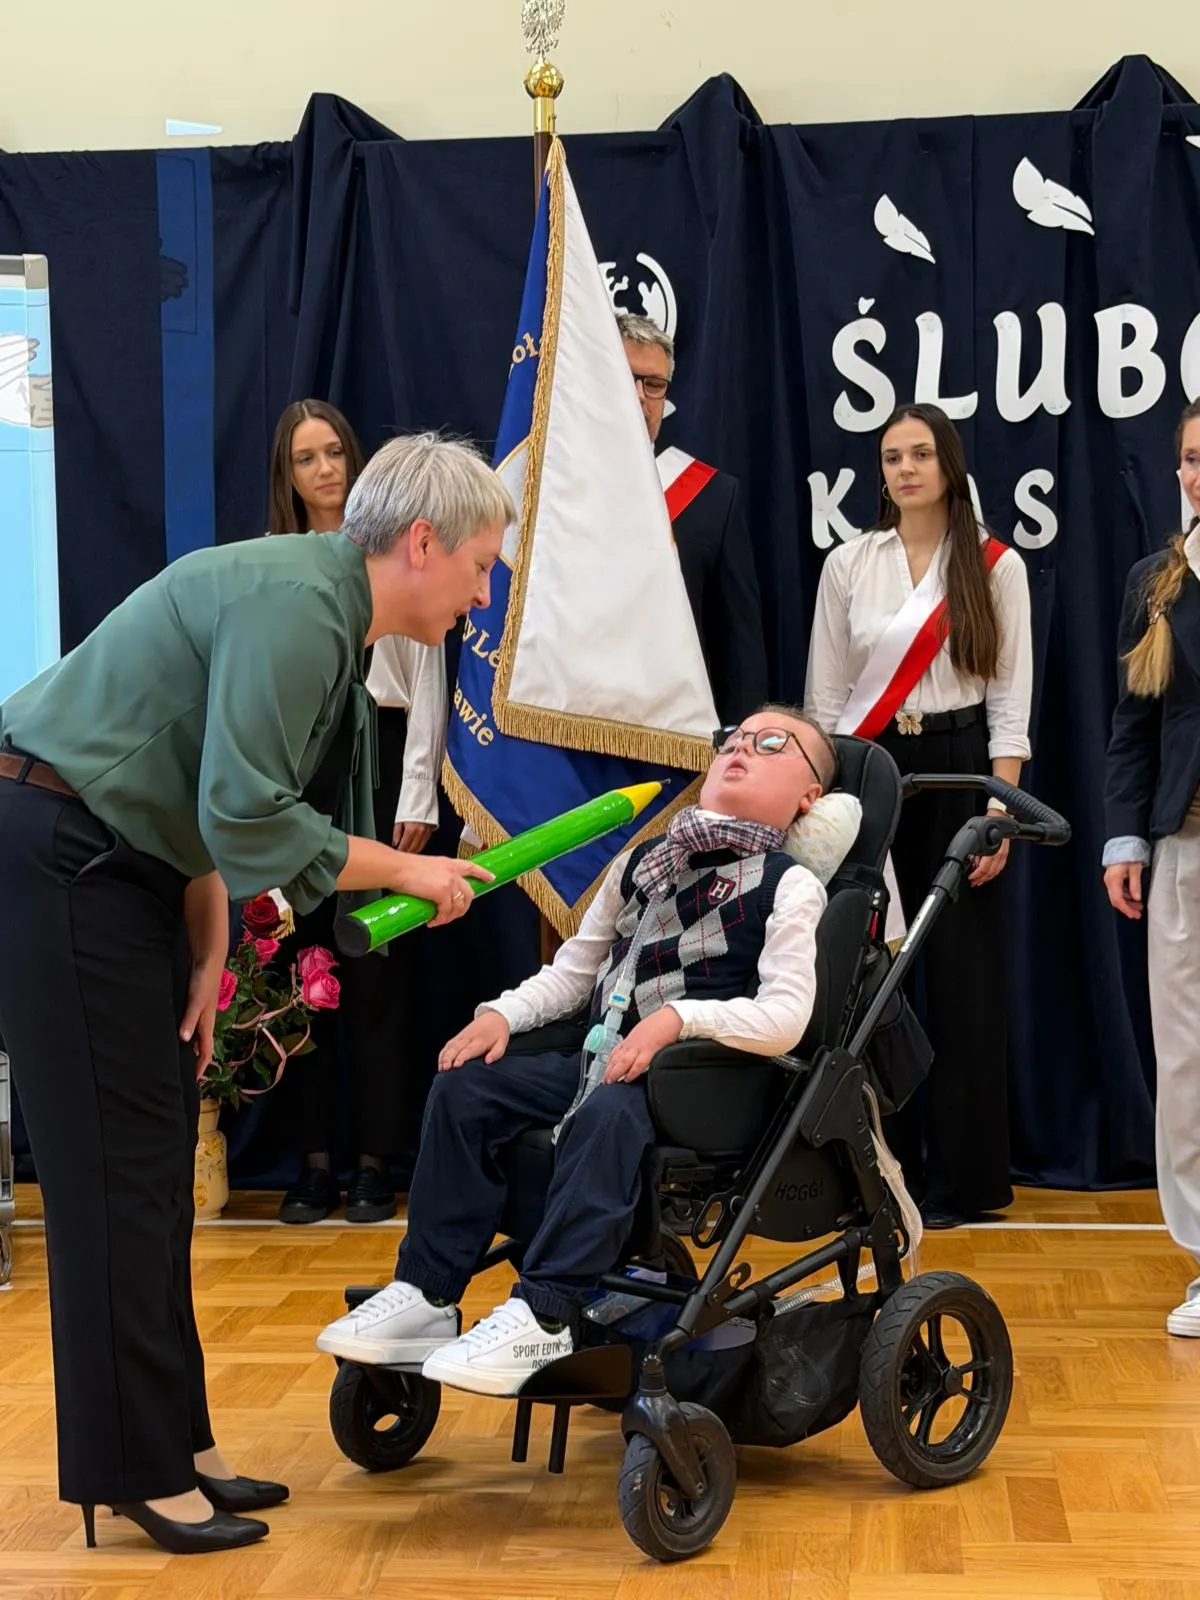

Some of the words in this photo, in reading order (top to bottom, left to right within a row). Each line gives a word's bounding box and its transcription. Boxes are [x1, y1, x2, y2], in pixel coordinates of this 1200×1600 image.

[832, 297, 1200, 433] ŚLUB
[807, 468, 1059, 550] KS
[471, 629, 501, 668] Le
[453, 680, 494, 746] awie
[710, 881, 729, 899] H
[775, 1179, 823, 1200] HOGGI
[513, 1344, 540, 1358] SPORT
